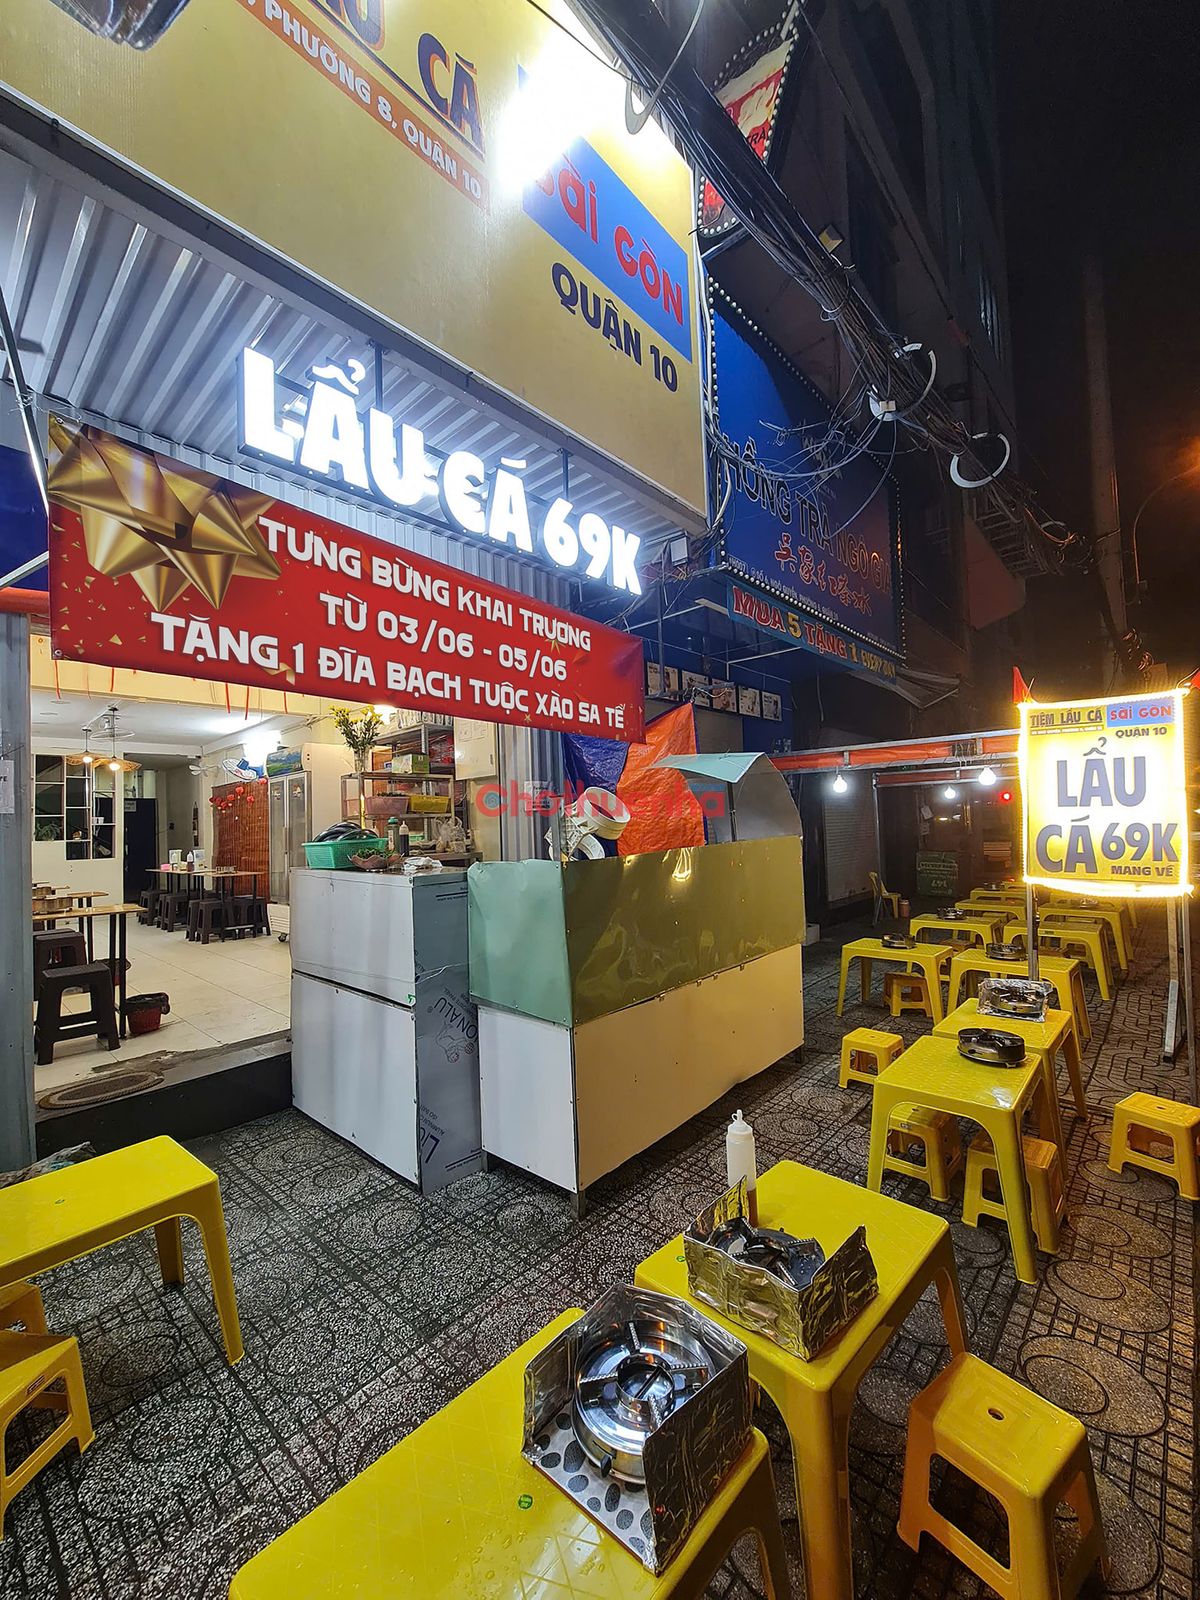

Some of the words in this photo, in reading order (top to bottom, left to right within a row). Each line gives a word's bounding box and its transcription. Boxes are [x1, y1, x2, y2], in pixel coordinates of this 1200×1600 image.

[264, 0, 372, 105] PHƯỜNG
[377, 95, 398, 129] 8,
[403, 118, 457, 180] QUẬN
[462, 169, 482, 199] 10
[614, 237, 684, 326] GÒN
[551, 261, 642, 366] QUẬN
[650, 344, 679, 393] 10
[243, 346, 426, 507] LẨU
[442, 450, 534, 553] CÁ
[542, 496, 643, 596] 69K
[258, 514, 362, 579] TƯNG
[371, 555, 450, 607] BỪNG
[457, 585, 513, 628] KHAI
[518, 607, 592, 652] TRƯƠNG
[732, 585, 787, 633] MUA
[786, 611, 802, 638] 5
[803, 621, 848, 660] TẶNG
[847, 642, 858, 663] 1
[150, 611, 280, 671] TẶNG
[292, 642, 305, 674] 1
[317, 645, 377, 687] ĐĨA
[386, 660, 463, 701] BẠCH
[468, 677, 530, 715] TUỘC
[534, 689, 574, 721] XÀO
[578, 702, 601, 725] SA
[604, 702, 626, 730] TẾ
[318, 592, 368, 632] TỪ
[377, 610, 475, 659] 03/06
[498, 644, 568, 681] 05/06
[1055, 736, 1147, 808] LẨU
[1152, 726, 1168, 736] 10
[1035, 814, 1099, 874] CÁ
[1100, 821, 1180, 862] 69K
[1110, 864, 1152, 877] MANG
